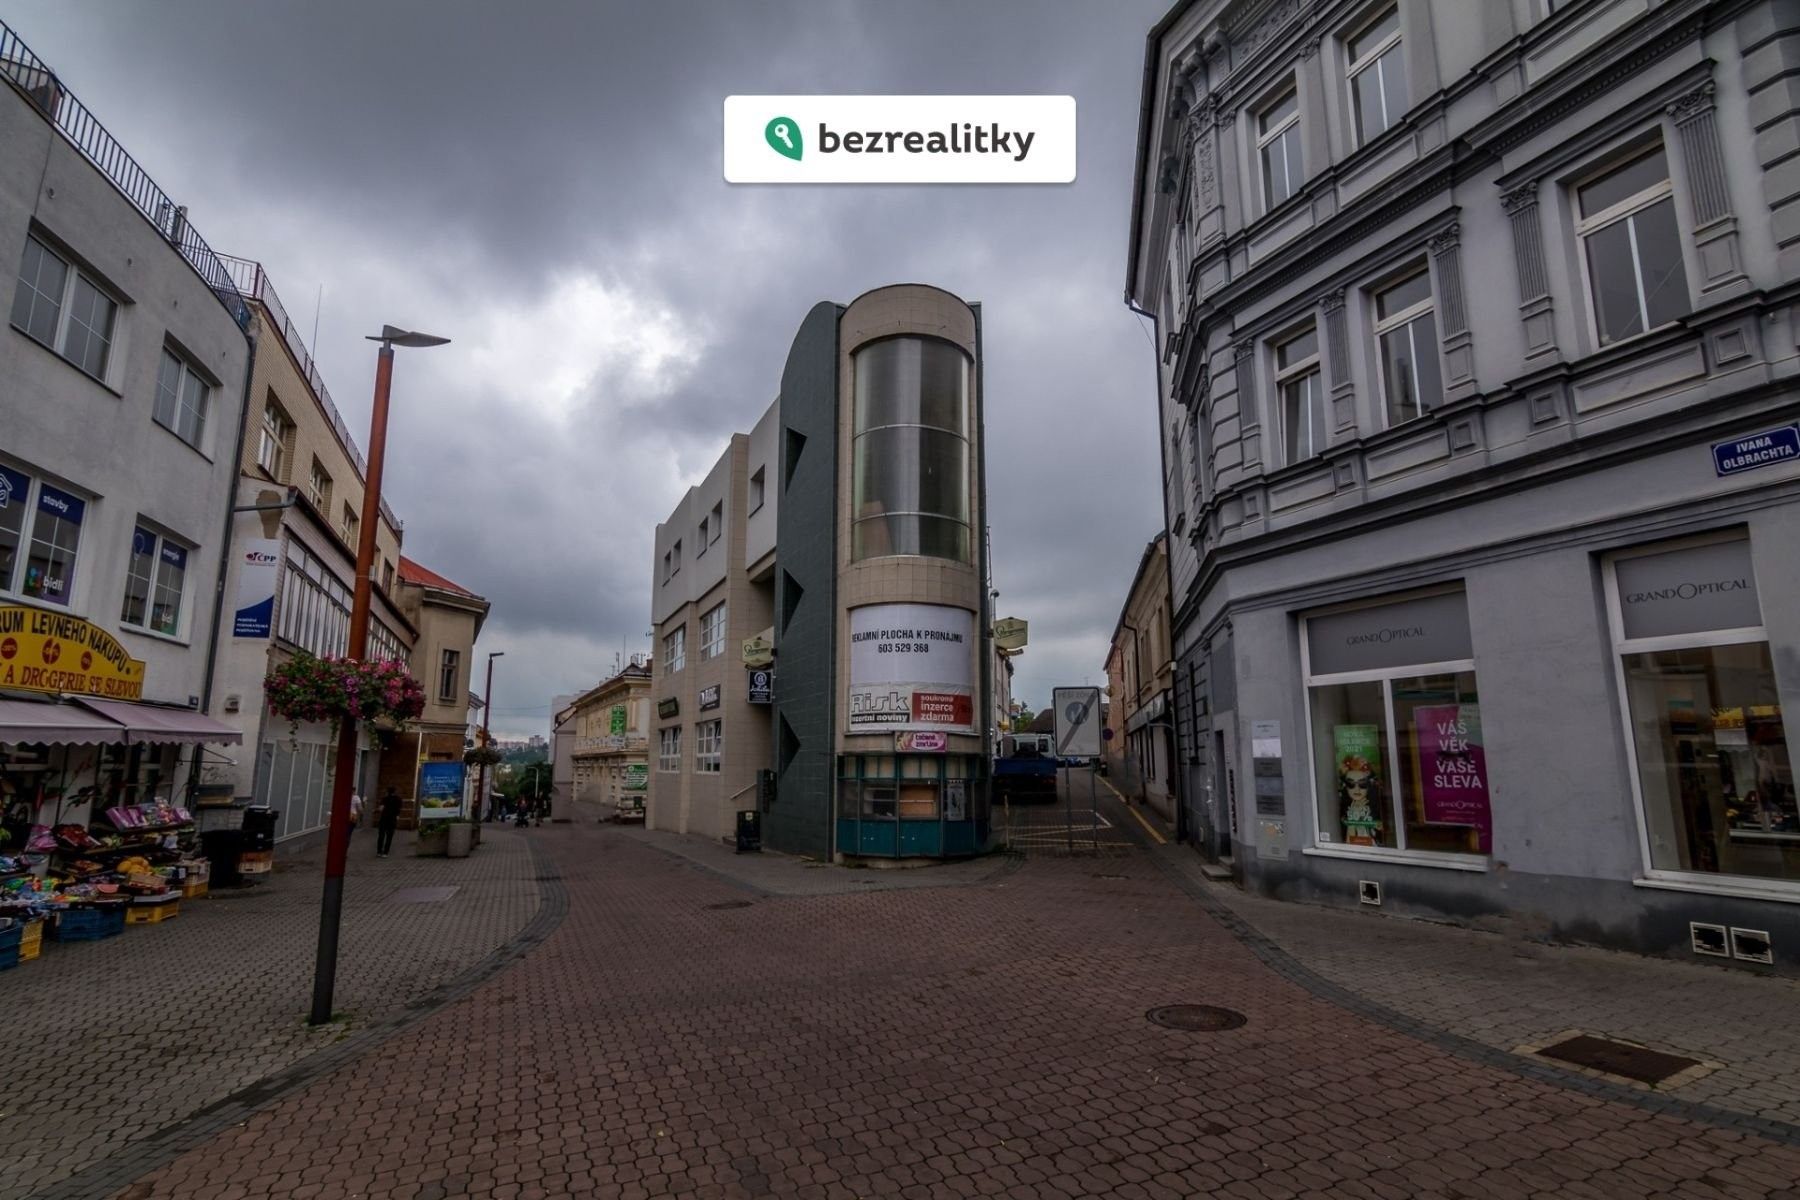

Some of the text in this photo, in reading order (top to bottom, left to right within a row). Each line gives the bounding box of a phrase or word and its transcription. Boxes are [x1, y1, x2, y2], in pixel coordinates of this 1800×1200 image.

[1736, 436, 1773, 454] IVANA
[1723, 444, 1794, 470] OLBRACHTA
[42, 494, 69, 513] stavby
[881, 629, 914, 640] PLOCHA
[917, 630, 922, 639] K
[878, 643, 929, 653] 603 529 368
[4, 664, 140, 698] A DROGERIE SE SLEVOU
[851, 691, 910, 713] Risk
[920, 702, 954, 712] inzerce
[876, 713, 908, 723] noviny
[920, 712, 954, 722] zdarma
[1437, 719, 1468, 736] VÁŠ
[1439, 736, 1469, 752] VĚK
[1436, 758, 1477, 774] VAŠE
[1434, 775, 1482, 788] SLEVA
